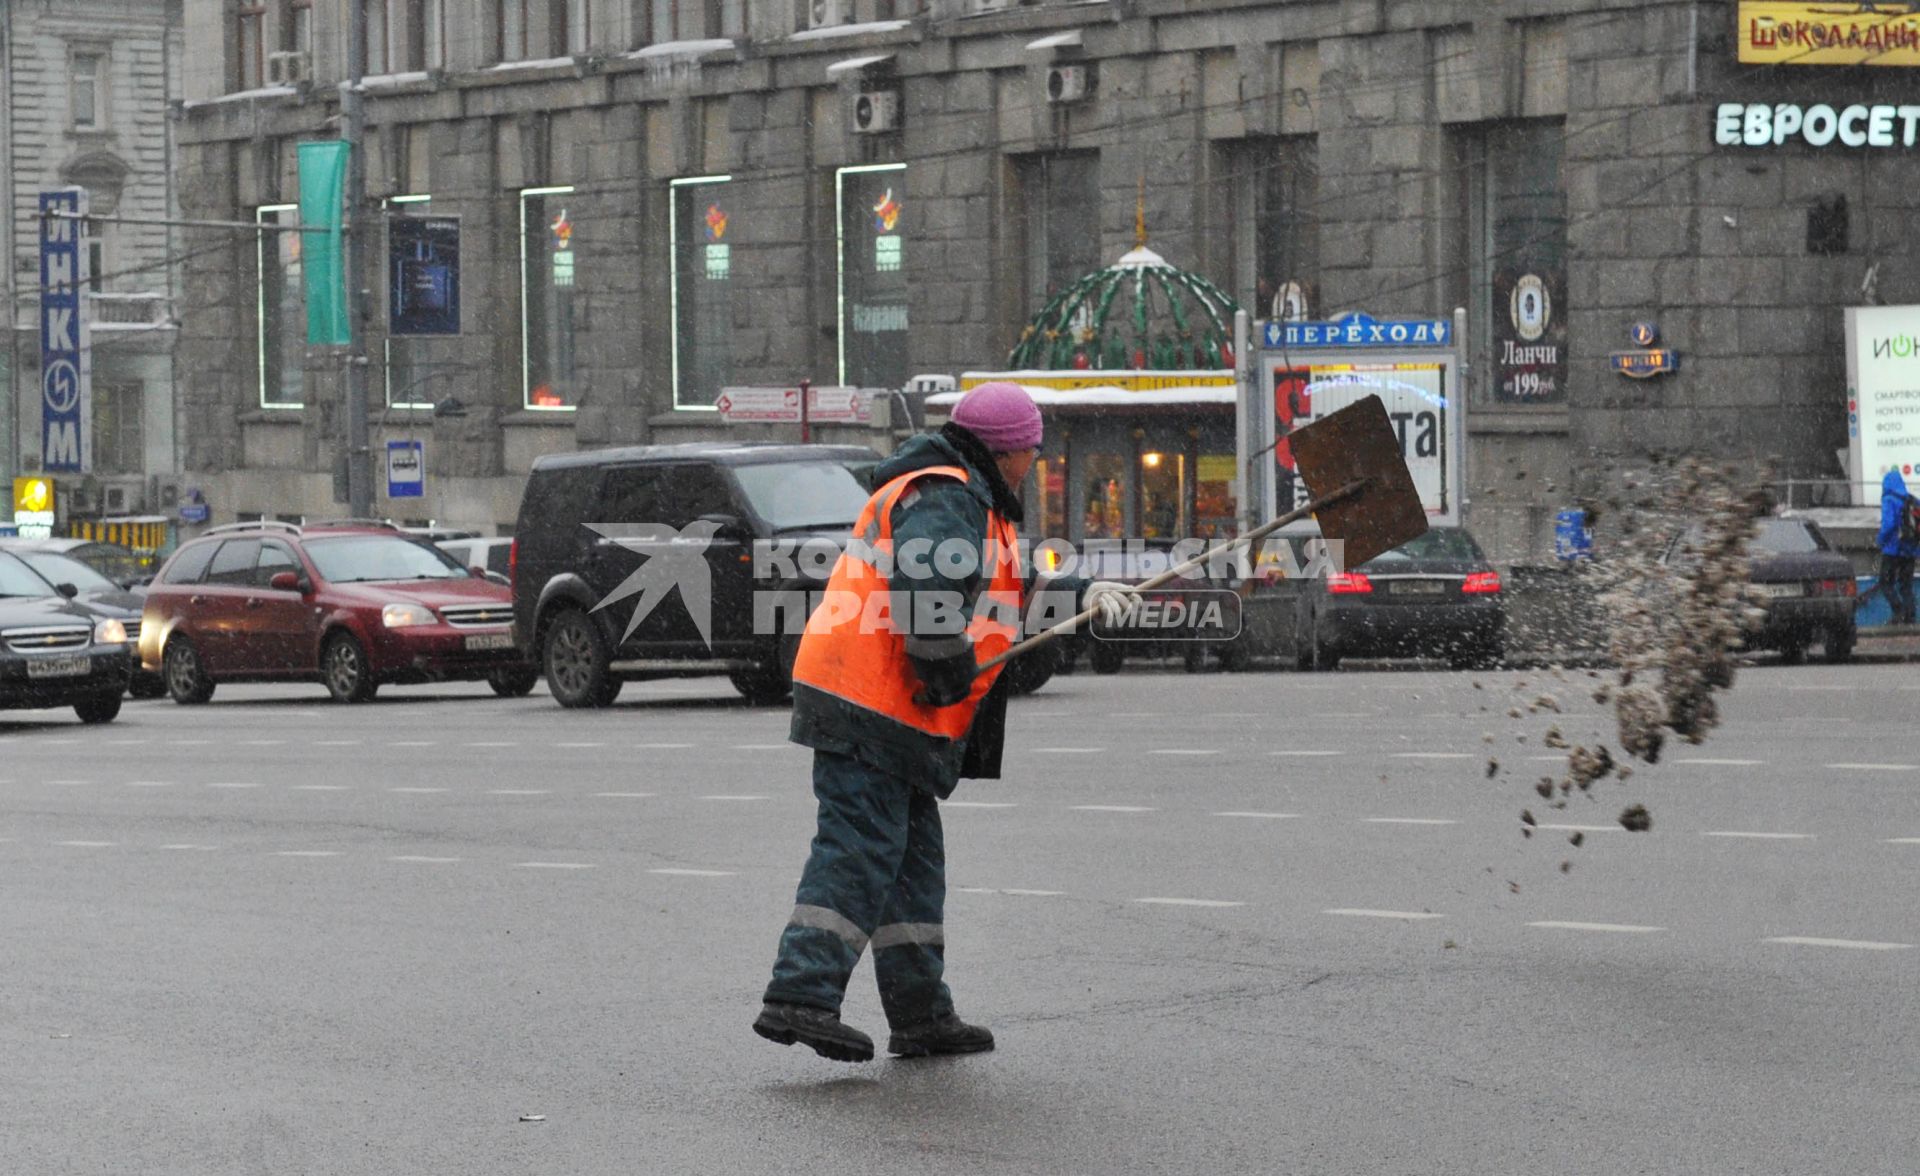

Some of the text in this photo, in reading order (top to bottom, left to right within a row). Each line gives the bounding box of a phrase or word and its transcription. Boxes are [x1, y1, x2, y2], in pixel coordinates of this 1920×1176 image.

[1716, 103, 1920, 147] ЕВРОСЕТ
[1286, 325, 1428, 344] ПЕРЕХОД
[1501, 341, 1556, 365] Ланчи
[1515, 373, 1538, 395] 199
[1875, 390, 1920, 401] СМАРТФО
[1877, 421, 1903, 432] ФОТО
